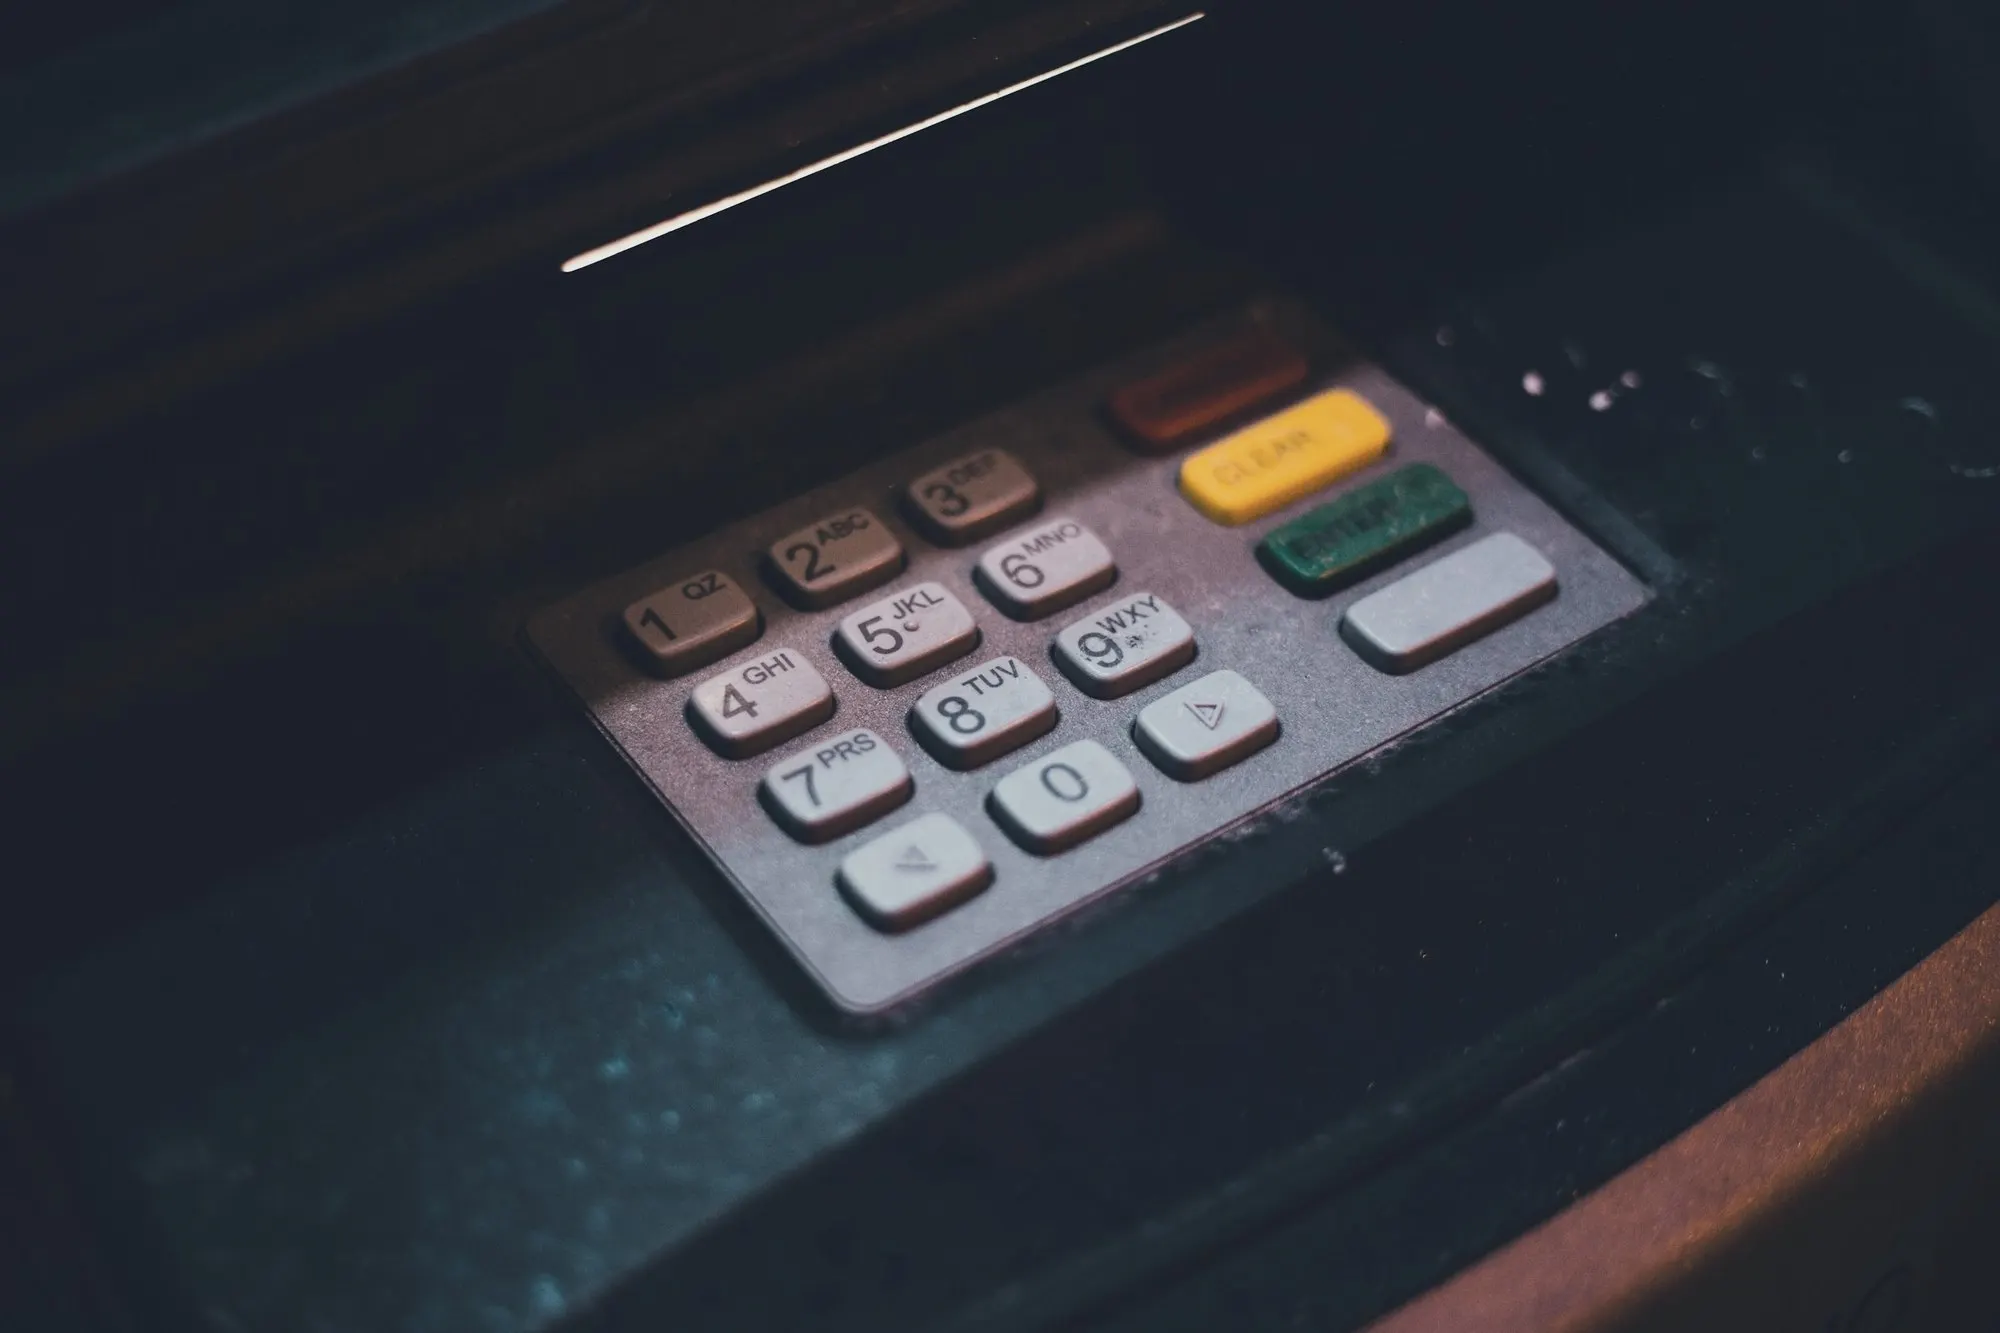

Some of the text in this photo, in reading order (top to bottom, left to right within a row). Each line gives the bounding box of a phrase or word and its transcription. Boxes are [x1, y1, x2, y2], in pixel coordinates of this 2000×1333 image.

[922, 480, 970, 517] 3
[786, 513, 870, 582] 2 ABC
[1000, 522, 1081, 589] 6 MNO
[639, 573, 727, 641] 1 QZ
[857, 589, 945, 655] 5 JKL
[1077, 595, 1161, 668] 9 WXY
[721, 652, 796, 720] 4 GHI
[937, 659, 1019, 734] 8 TUV
[780, 732, 877, 806] 7 PRS
[1040, 762, 1088, 803] 0
